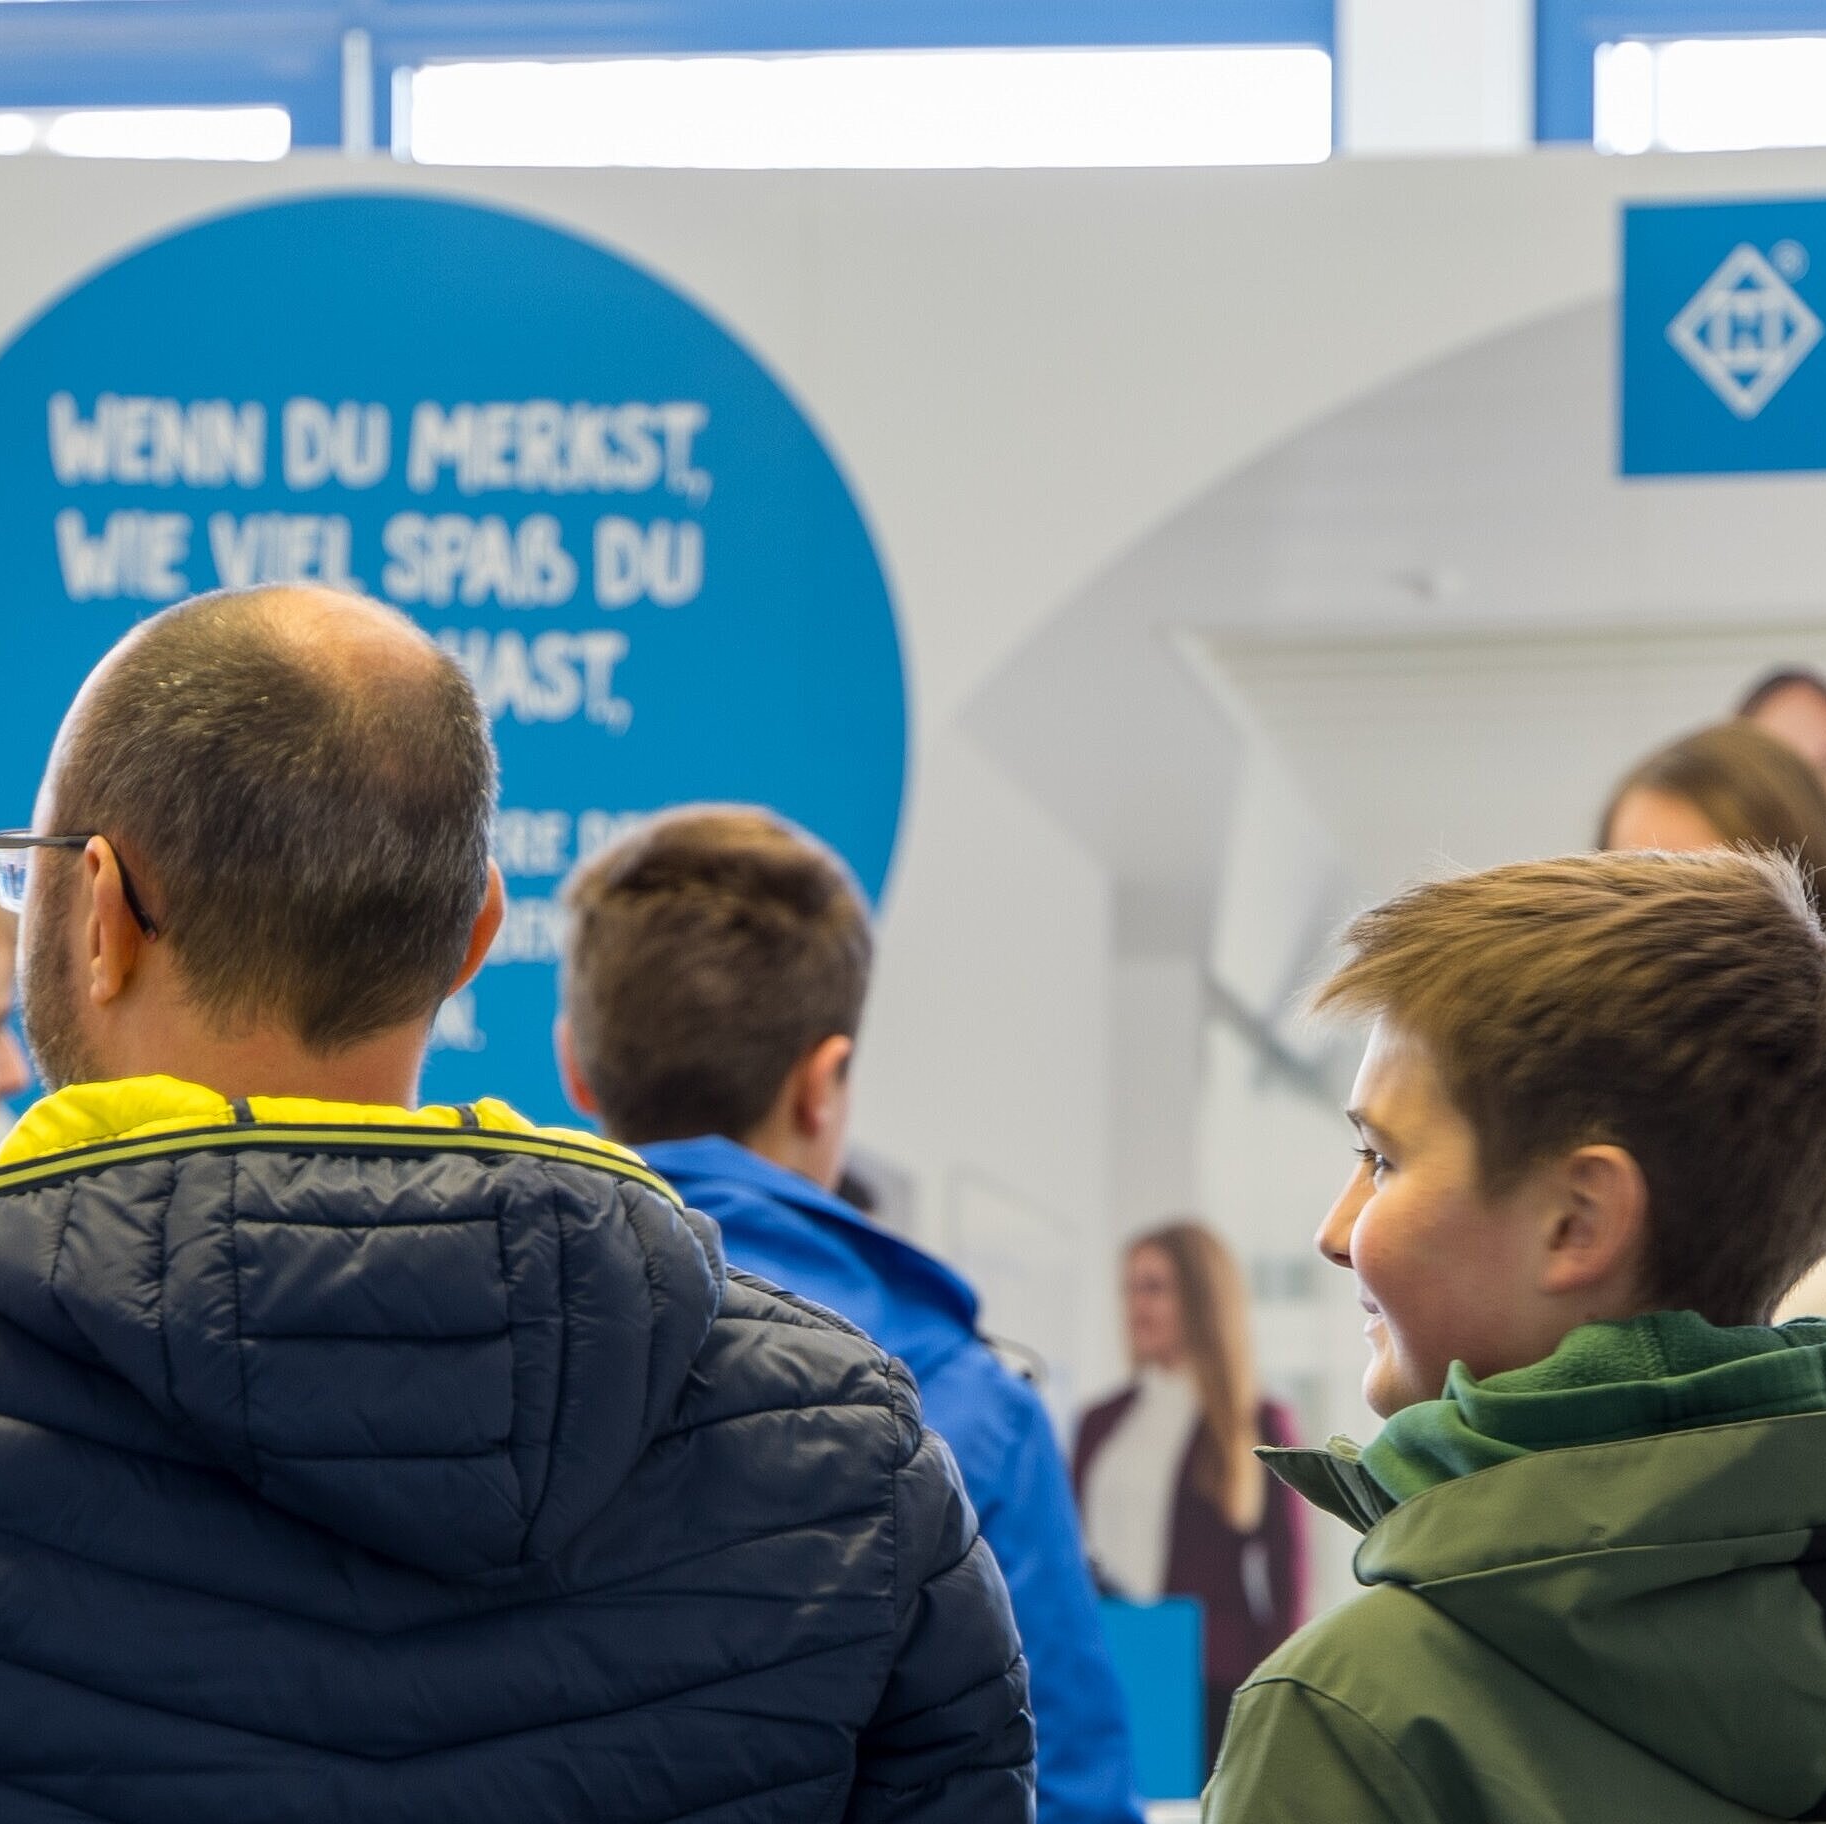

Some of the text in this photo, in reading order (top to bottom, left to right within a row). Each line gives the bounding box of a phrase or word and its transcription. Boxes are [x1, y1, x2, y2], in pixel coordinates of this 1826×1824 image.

[48, 392, 711, 508] WENN DU MERKST,
[55, 508, 192, 601] WIE
[208, 510, 367, 592] VIEL
[594, 515, 703, 608] DU
